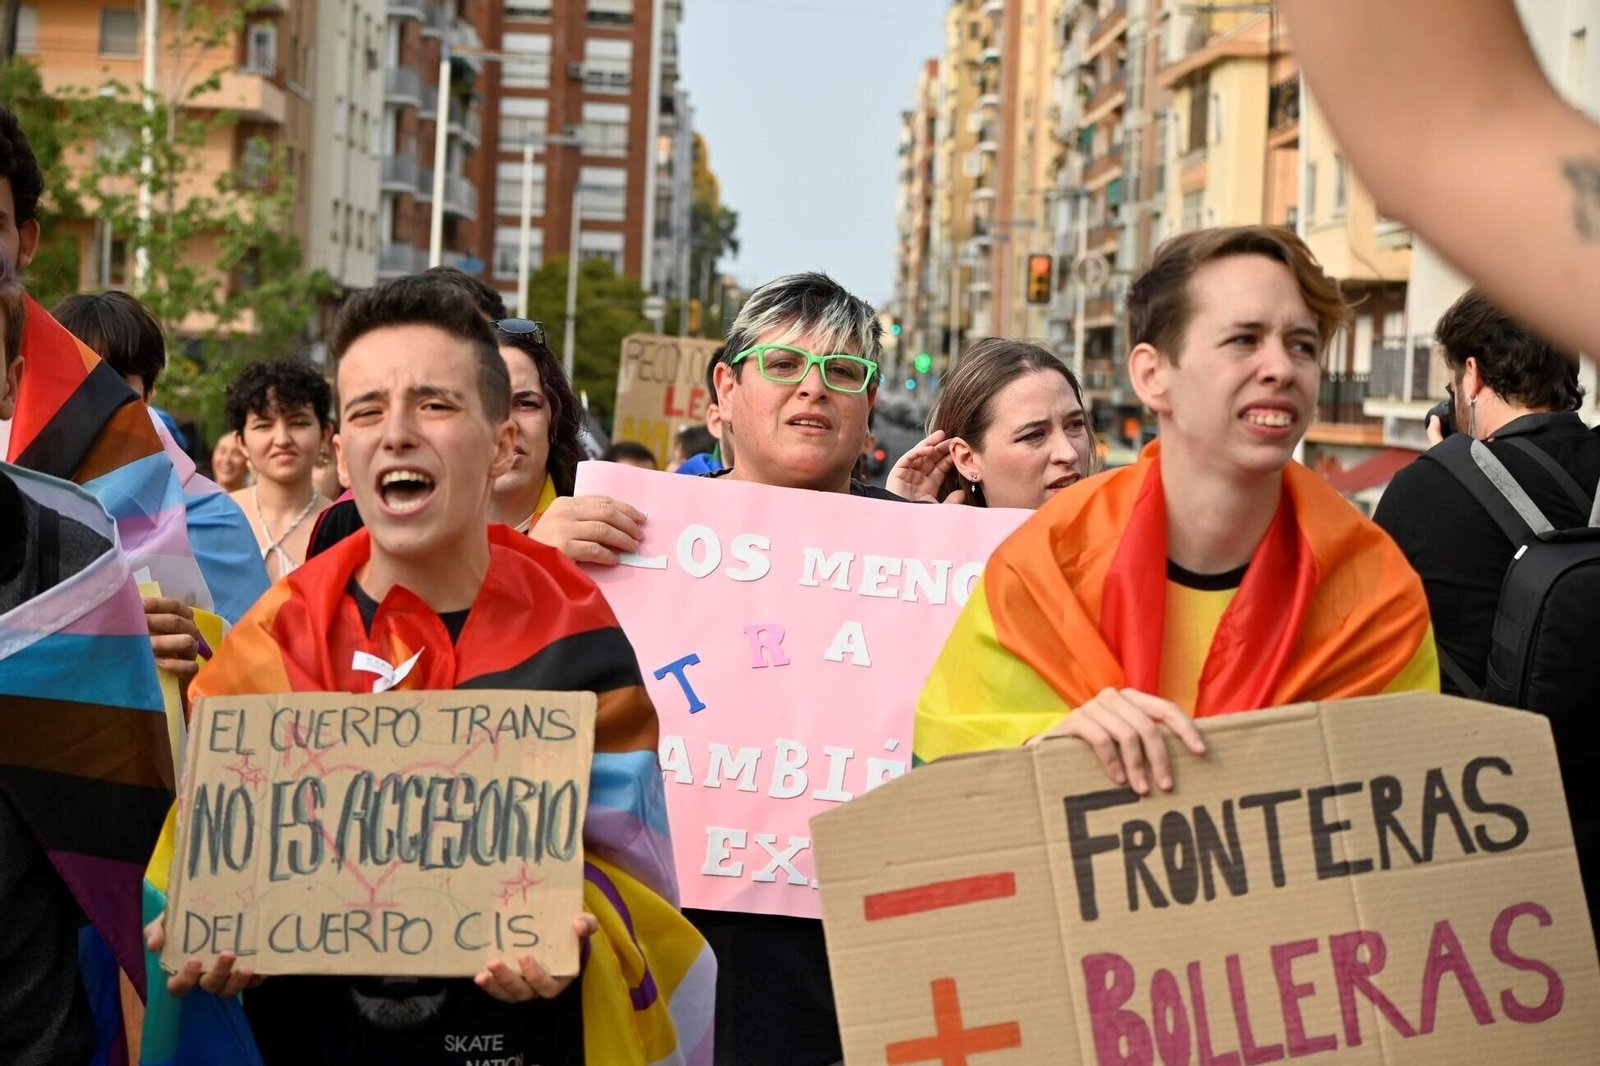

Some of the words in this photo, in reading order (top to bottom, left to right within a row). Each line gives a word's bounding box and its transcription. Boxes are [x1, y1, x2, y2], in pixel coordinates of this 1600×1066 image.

[208, 708, 257, 755] EL
[270, 705, 422, 752] CUERPO
[437, 703, 577, 746] TRANS
[188, 781, 255, 882] NO
[269, 775, 325, 882] ES
[334, 770, 580, 874] ACCESORIO
[701, 826, 819, 890] EX
[1063, 756, 1530, 922] FRONTERAS
[183, 910, 258, 957] DEL
[268, 909, 433, 956] CUERPO
[454, 911, 541, 953] CIS
[1080, 901, 1565, 1066] BOLLERAS
[444, 1033, 506, 1052] SKATE
